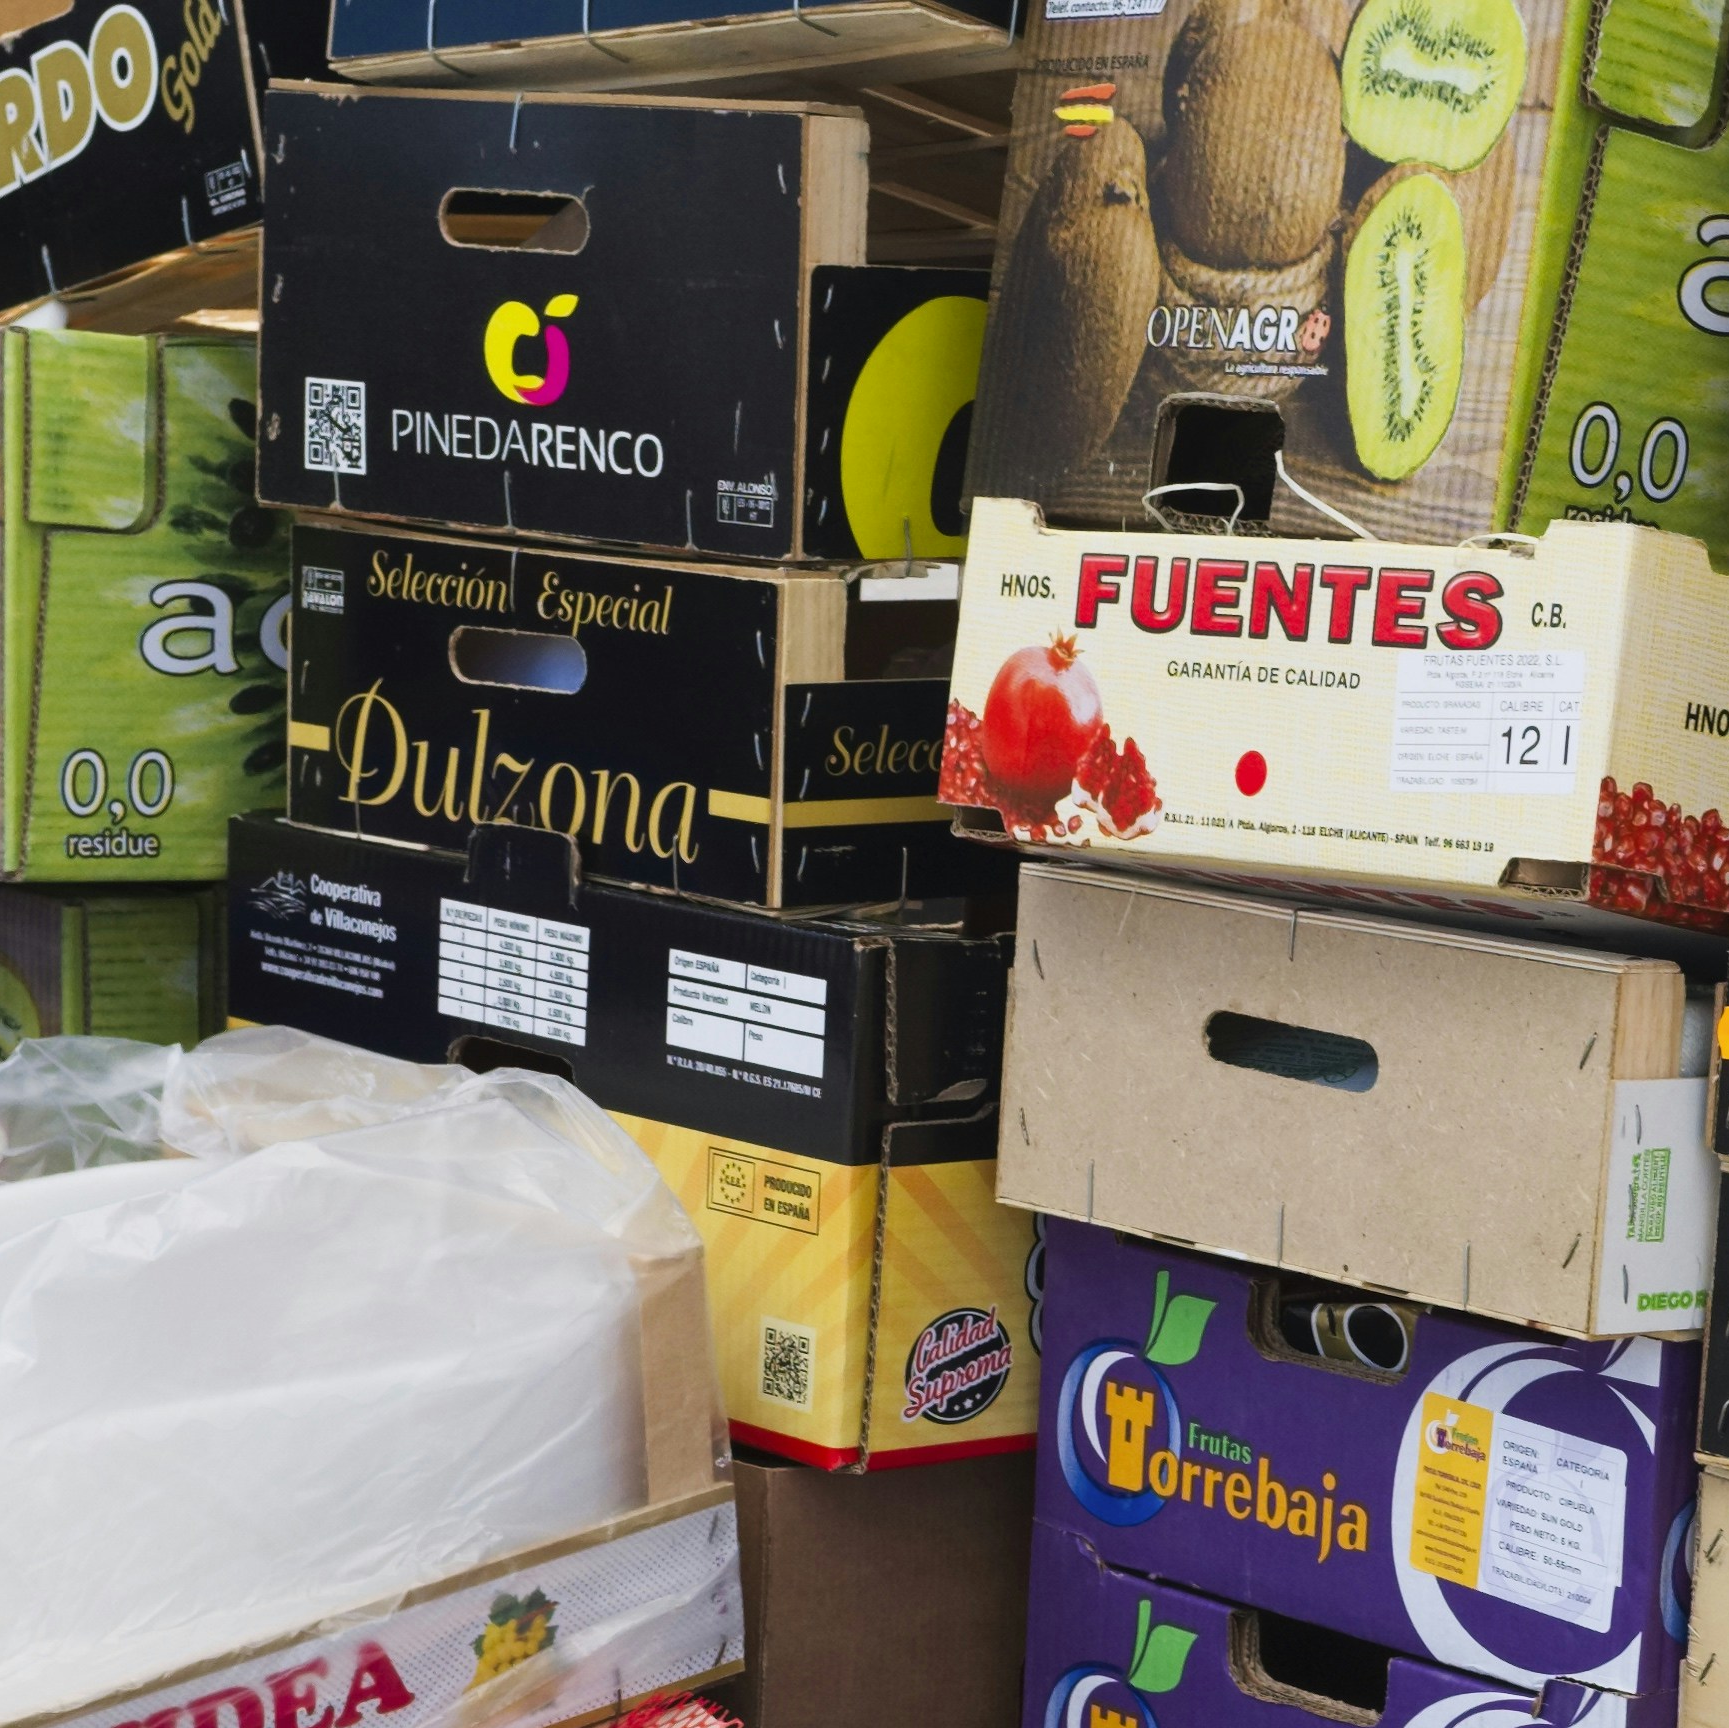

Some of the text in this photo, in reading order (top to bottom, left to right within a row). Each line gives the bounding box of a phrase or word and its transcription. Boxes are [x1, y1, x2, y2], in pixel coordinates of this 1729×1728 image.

[162, 0, 222, 132] Gold
[392, 409, 663, 478] PINEDARENCO
[1570, 402, 1689, 503] 0,0
[366, 549, 510, 614] Selección
[536, 569, 673, 635] Especial
[1000, 552, 1567, 651] HNOS. FUENTES C.B.
[1166, 658, 1362, 690] GARANTÍA DE CALIDAD
[1423, 655, 1514, 666] FRUTAS FUENTES
[1500, 701, 1543, 713] CALIBRE
[1501, 725, 1541, 765] 12
[60, 749, 175, 825] 0,0
[335, 678, 700, 864] Dulzona
[65, 827, 160, 858] residue
[310, 873, 382, 908] Cooperativa
[310, 906, 398, 943] de Villaconejos
[763, 1174, 812, 1199] PRODUCIDO
[763, 1196, 812, 1223] EN ESPAÑA
[917, 1304, 999, 1375] Calidad
[902, 1341, 1013, 1423] Suprema
[1187, 1420, 1253, 1465] Frutas
[1503, 1441, 1540, 1459] ORIGEN:
[1502, 1457, 1538, 1475] ESPAÑA
[1559, 1497, 1595, 1515] CIRUELA
[1509, 1520, 1531, 1534] PESO
[1560, 1518, 1583, 1532] GOLD
